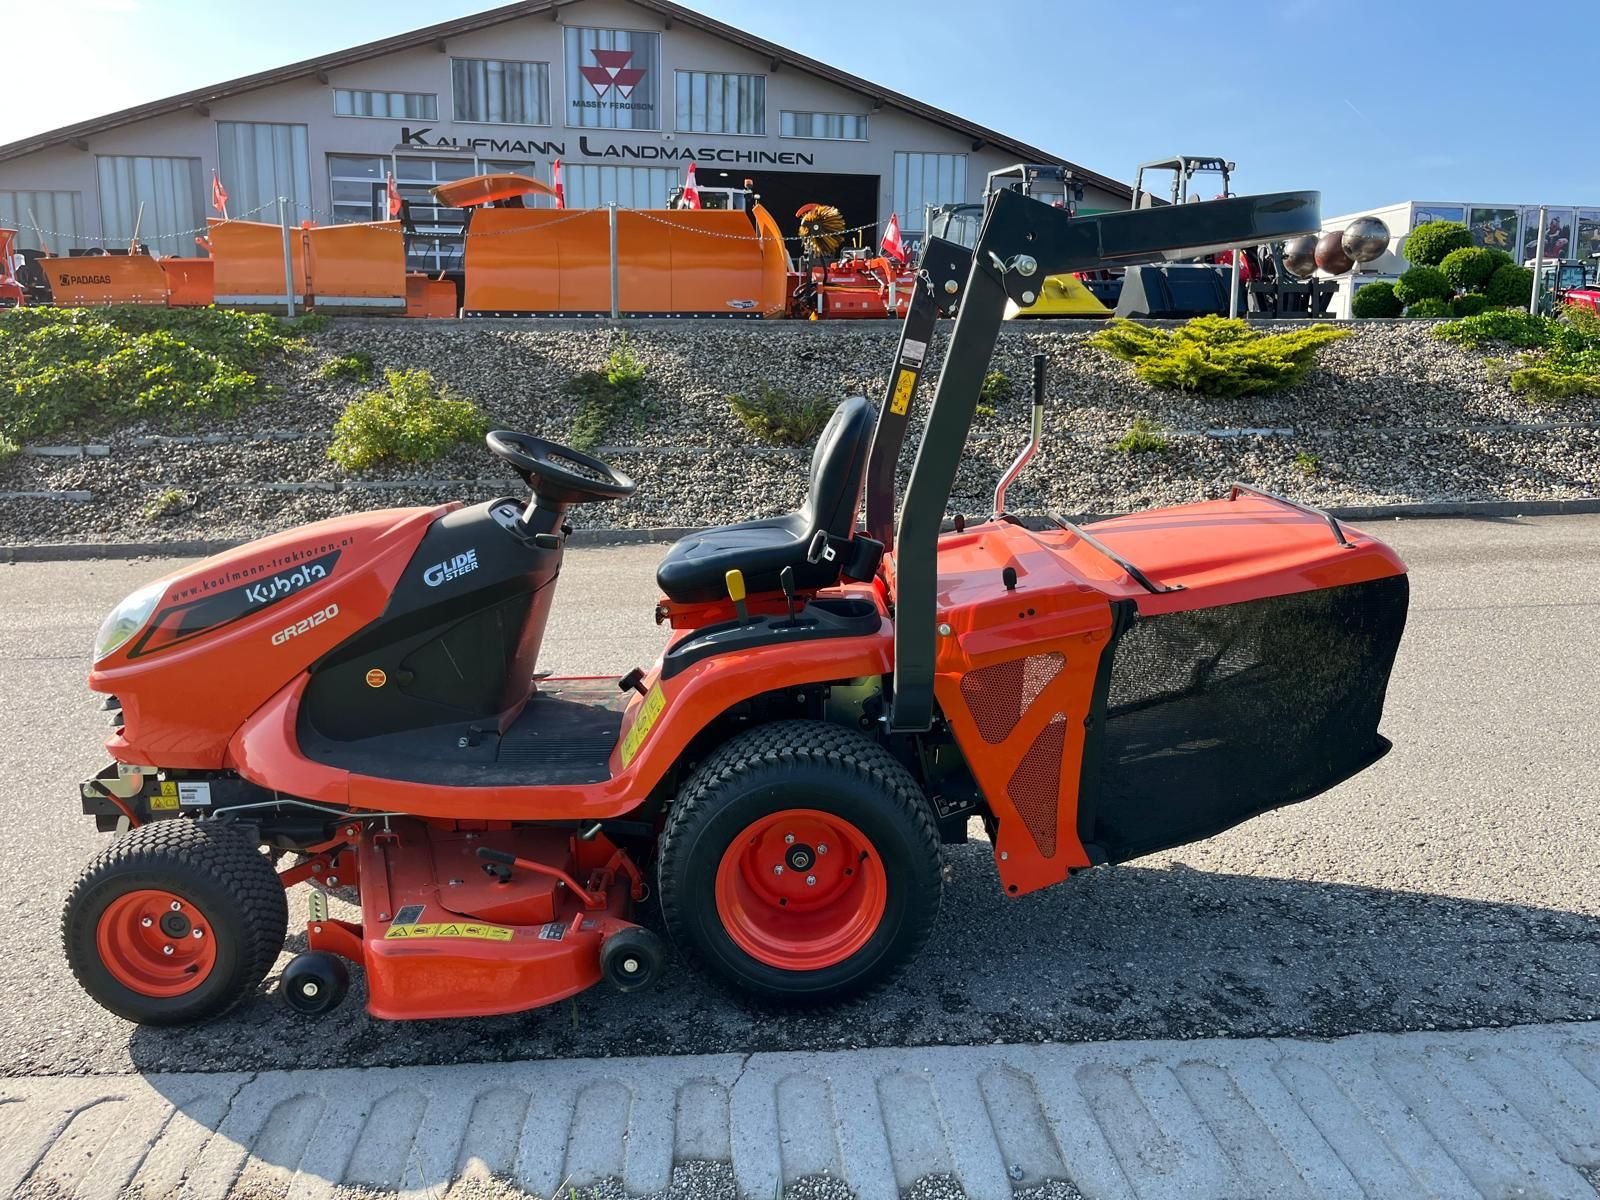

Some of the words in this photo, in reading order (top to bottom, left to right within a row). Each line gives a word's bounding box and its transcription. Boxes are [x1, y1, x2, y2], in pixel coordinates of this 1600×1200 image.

[573, 100, 607, 108] MASSEY
[610, 102, 654, 111] FERGUSON
[580, 135, 814, 165] LANDMASCHINEN
[70, 275, 111, 284] PADAGAS
[172, 537, 354, 601] www.kaufmann-traktoren.at
[245, 564, 327, 603] Kubota
[424, 548, 476, 587] GLIDE
[445, 561, 479, 582] STEER
[271, 603, 340, 647] GR2120
